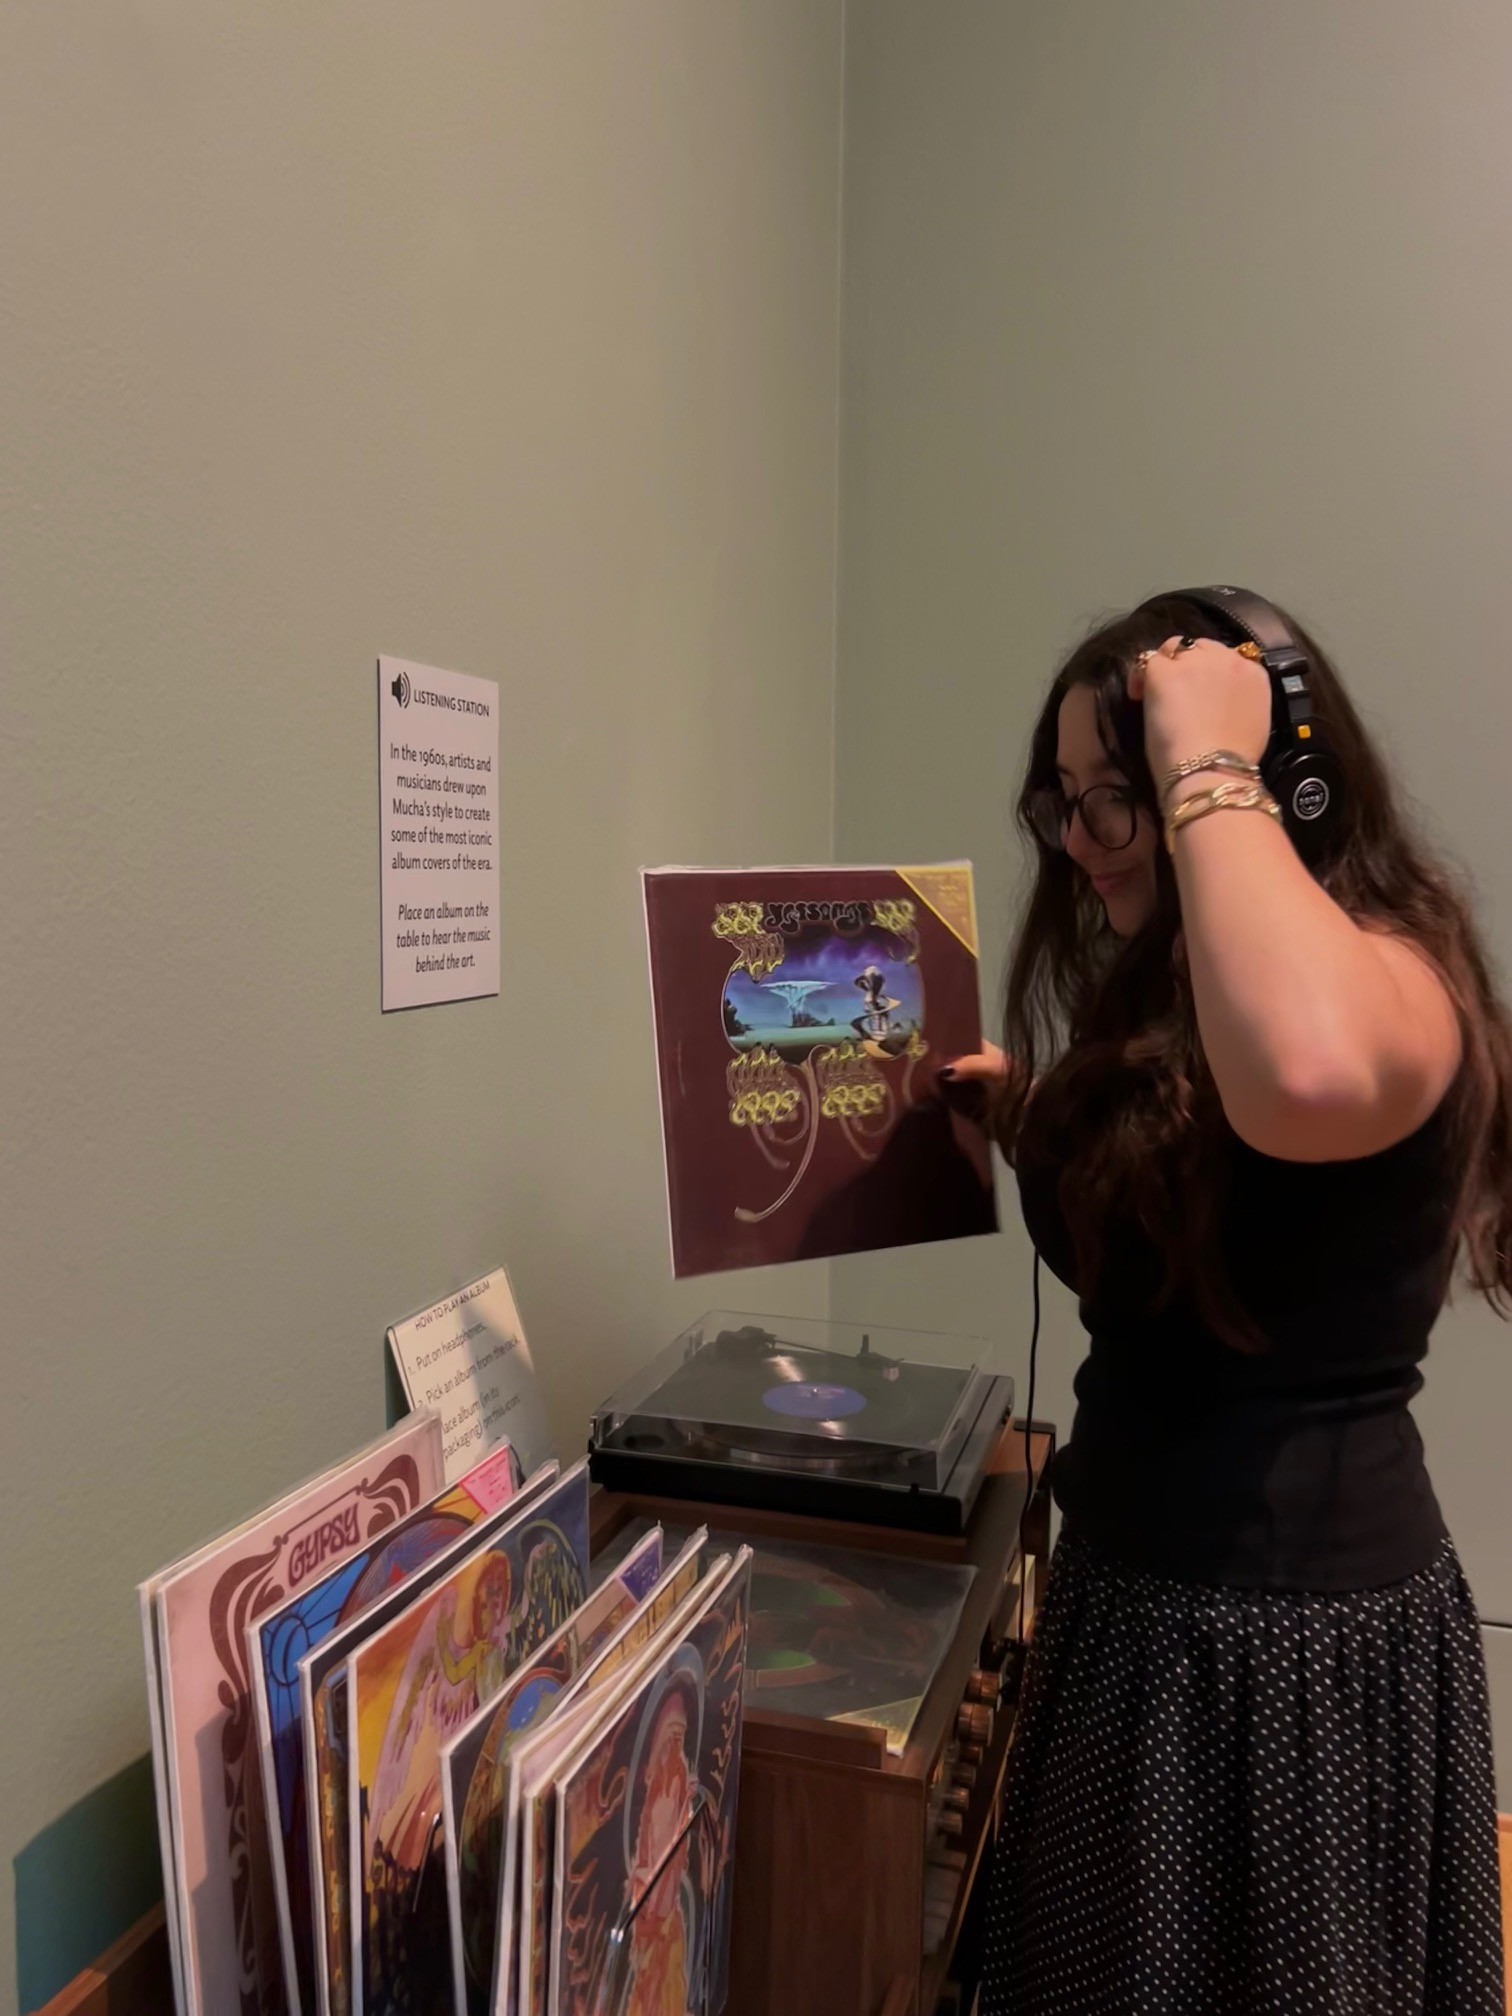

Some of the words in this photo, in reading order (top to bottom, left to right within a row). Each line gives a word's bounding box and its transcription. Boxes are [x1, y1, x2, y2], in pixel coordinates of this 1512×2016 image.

[414, 689, 456, 711] LISTENING
[457, 699, 490, 717] STATION
[391, 743, 400, 759] In
[402, 744, 417, 762] the
[419, 749, 447, 768] 1960s,
[449, 752, 475, 770] artists
[477, 757, 491, 772] and
[397, 773, 441, 792] musicians
[443, 777, 464, 794] drew
[466, 783, 486, 799] upon
[393, 798, 431, 817] Mucha's
[432, 803, 453, 822] style
[454, 806, 464, 820] to
[465, 808, 490, 821] create
[391, 829, 416, 843] some
[418, 826, 429, 843] of
[430, 827, 444, 844] the
[445, 831, 467, 845] most
[468, 830, 492, 846] iconic
[392, 852, 421, 870] album
[423, 857, 451, 870] covers
[452, 853, 461, 870] of
[462, 854, 476, 870] the
[477, 859, 493, 870] era.
[398, 904, 422, 921] Place
[424, 908, 435, 920] an
[436, 902, 463, 920] album
[464, 906, 474, 917] on
[476, 901, 489, 917] the
[396, 930, 420, 948] table
[421, 932, 430, 946] to
[432, 929, 452, 945] hear
[453, 927, 467, 943] the
[467, 926, 491, 942] music
[415, 954, 445, 973] behind
[446, 953, 460, 969] the
[461, 954, 475, 968] art.
[414, 1313, 434, 1331] HOW
[432, 1306, 444, 1319] TO
[443, 1299, 459, 1313] PLAY
[459, 1293, 470, 1304] AN
[469, 1280, 491, 1299] ALBUM
[416, 1354, 432, 1370] Put
[432, 1348, 442, 1362] on
[425, 1384, 443, 1404] Pick
[443, 1379, 454, 1394] an
[454, 1363, 477, 1387] album
[475, 1353, 492, 1370] from
[493, 1343, 506, 1358] the
[457, 1400, 480, 1424] album
[443, 1419, 482, 1461] packaging)
[287, 1501, 361, 1588] GYPSY
